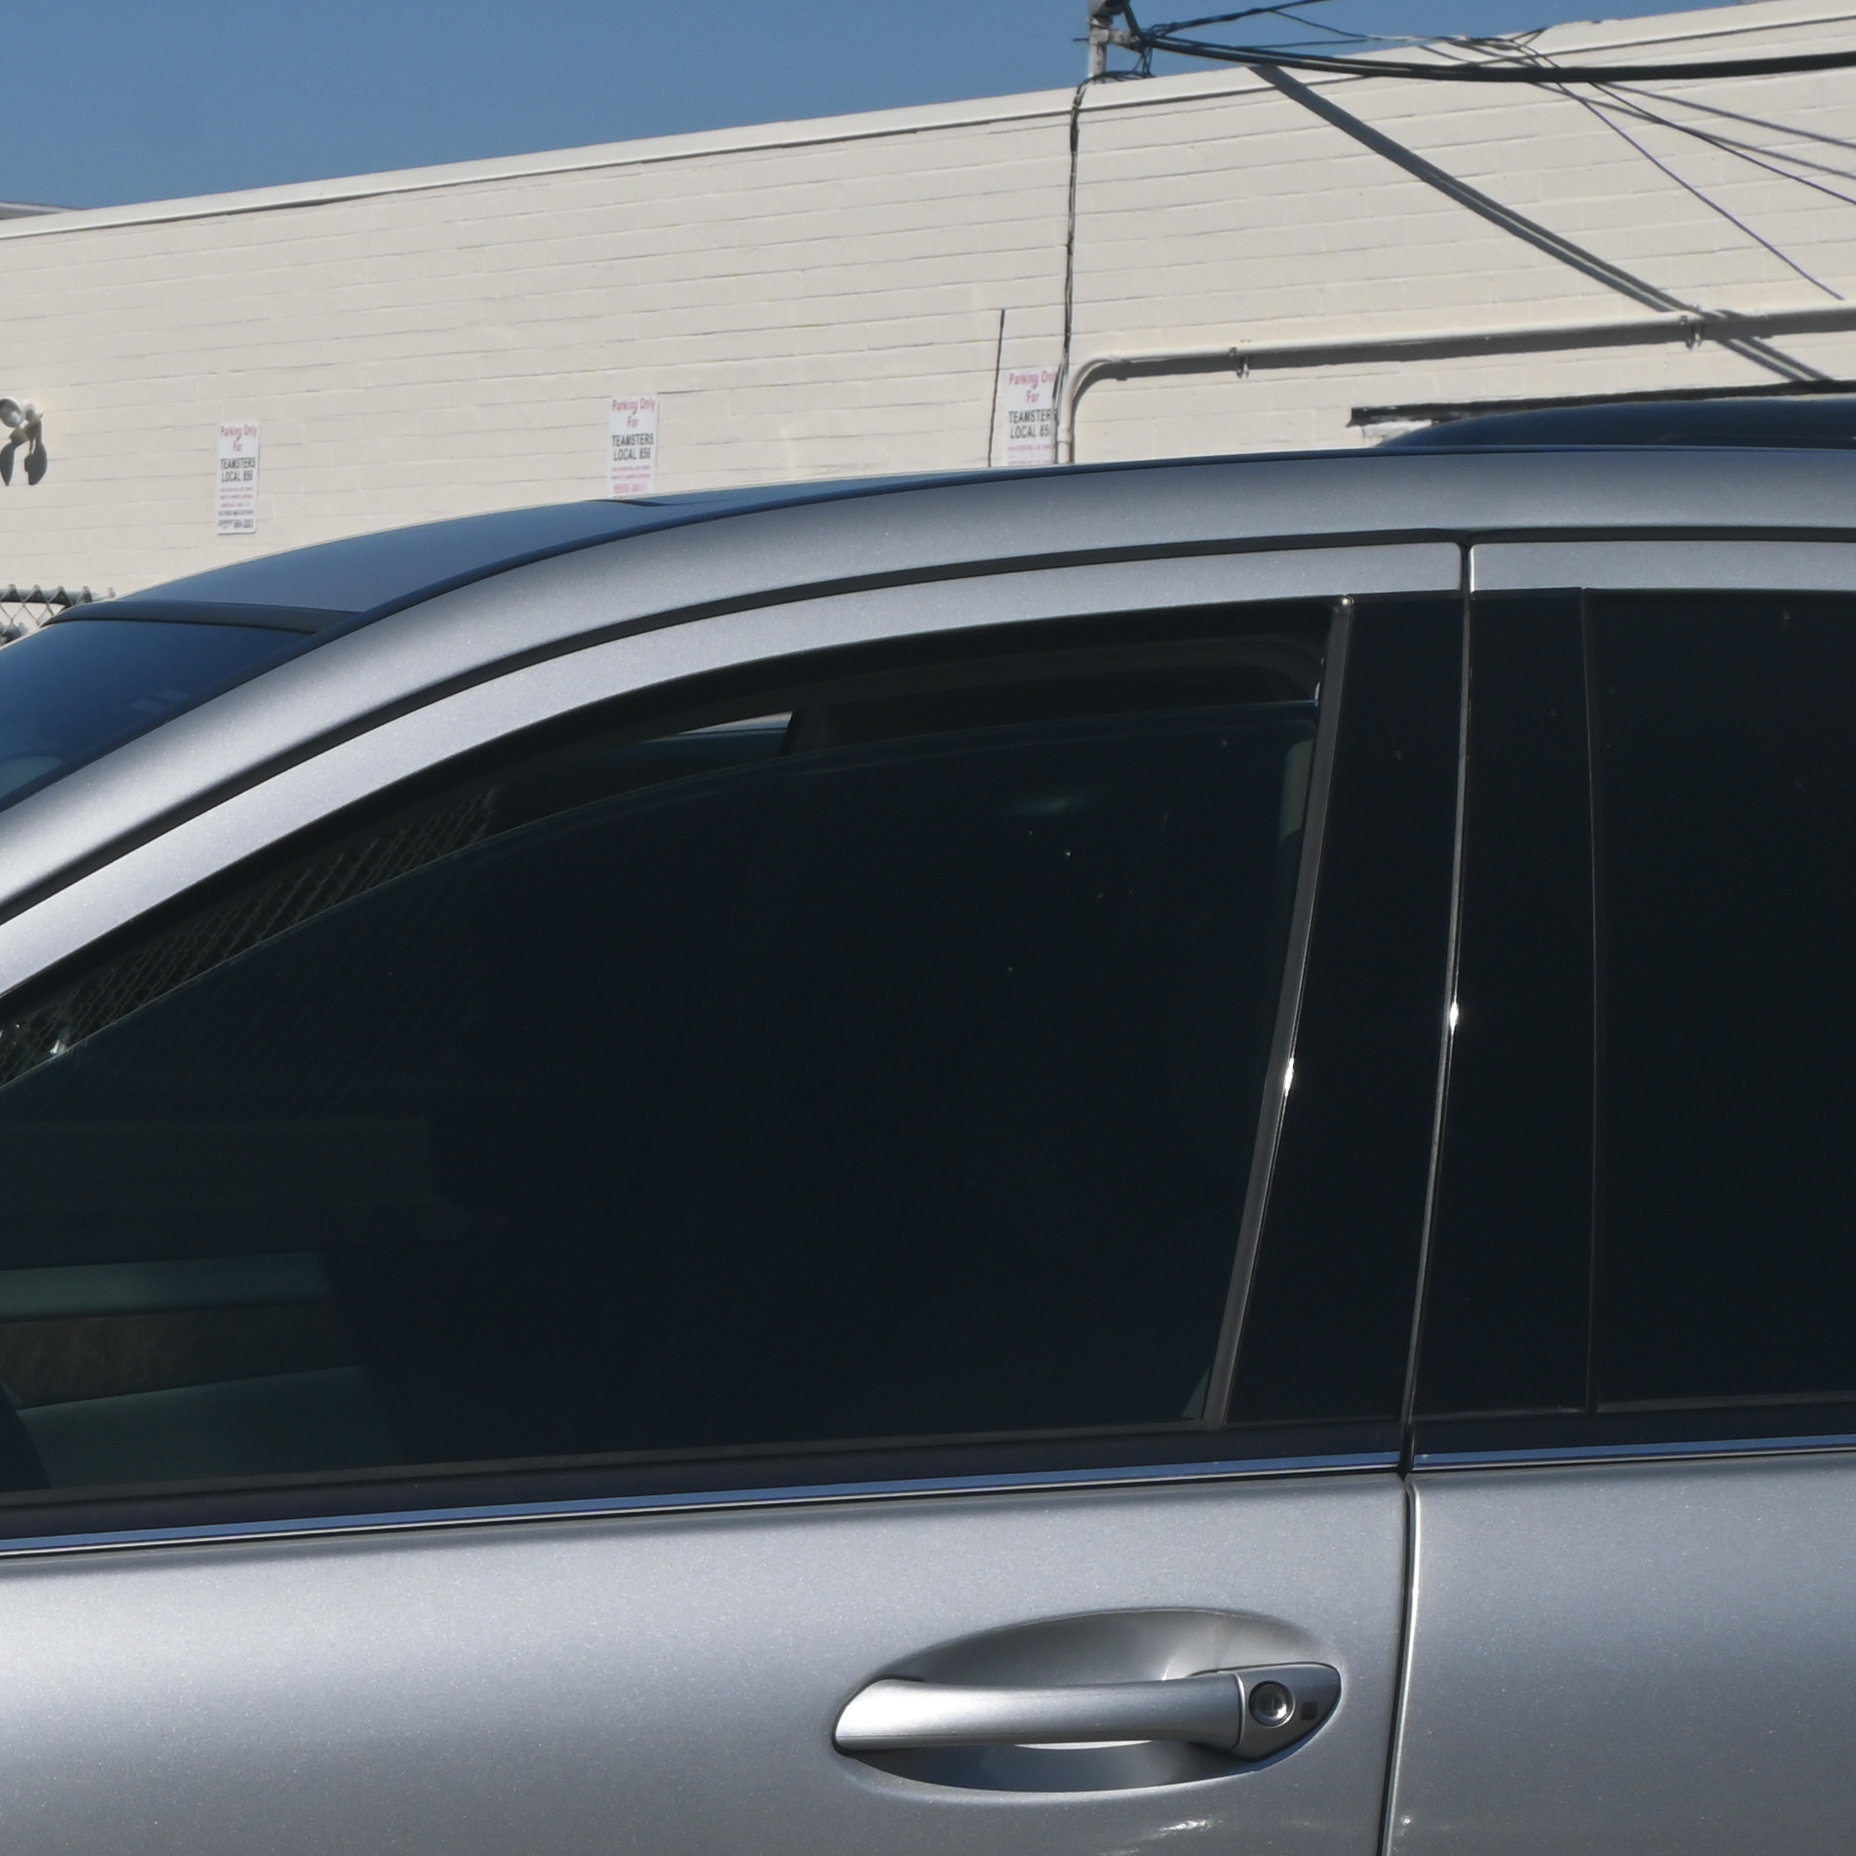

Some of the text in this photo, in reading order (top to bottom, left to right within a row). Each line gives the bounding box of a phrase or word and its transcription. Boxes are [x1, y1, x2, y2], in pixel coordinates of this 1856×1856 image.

[1009, 370, 1060, 390] Parking Onl
[612, 397, 656, 416] Parking Only
[611, 432, 654, 447] TEAMSTERS
[1010, 424, 1050, 440] LOCAL 85
[613, 448, 637, 461] LOCAL
[220, 457, 256, 470] TEAMSTERS
[221, 470, 241, 482] LOCAL
